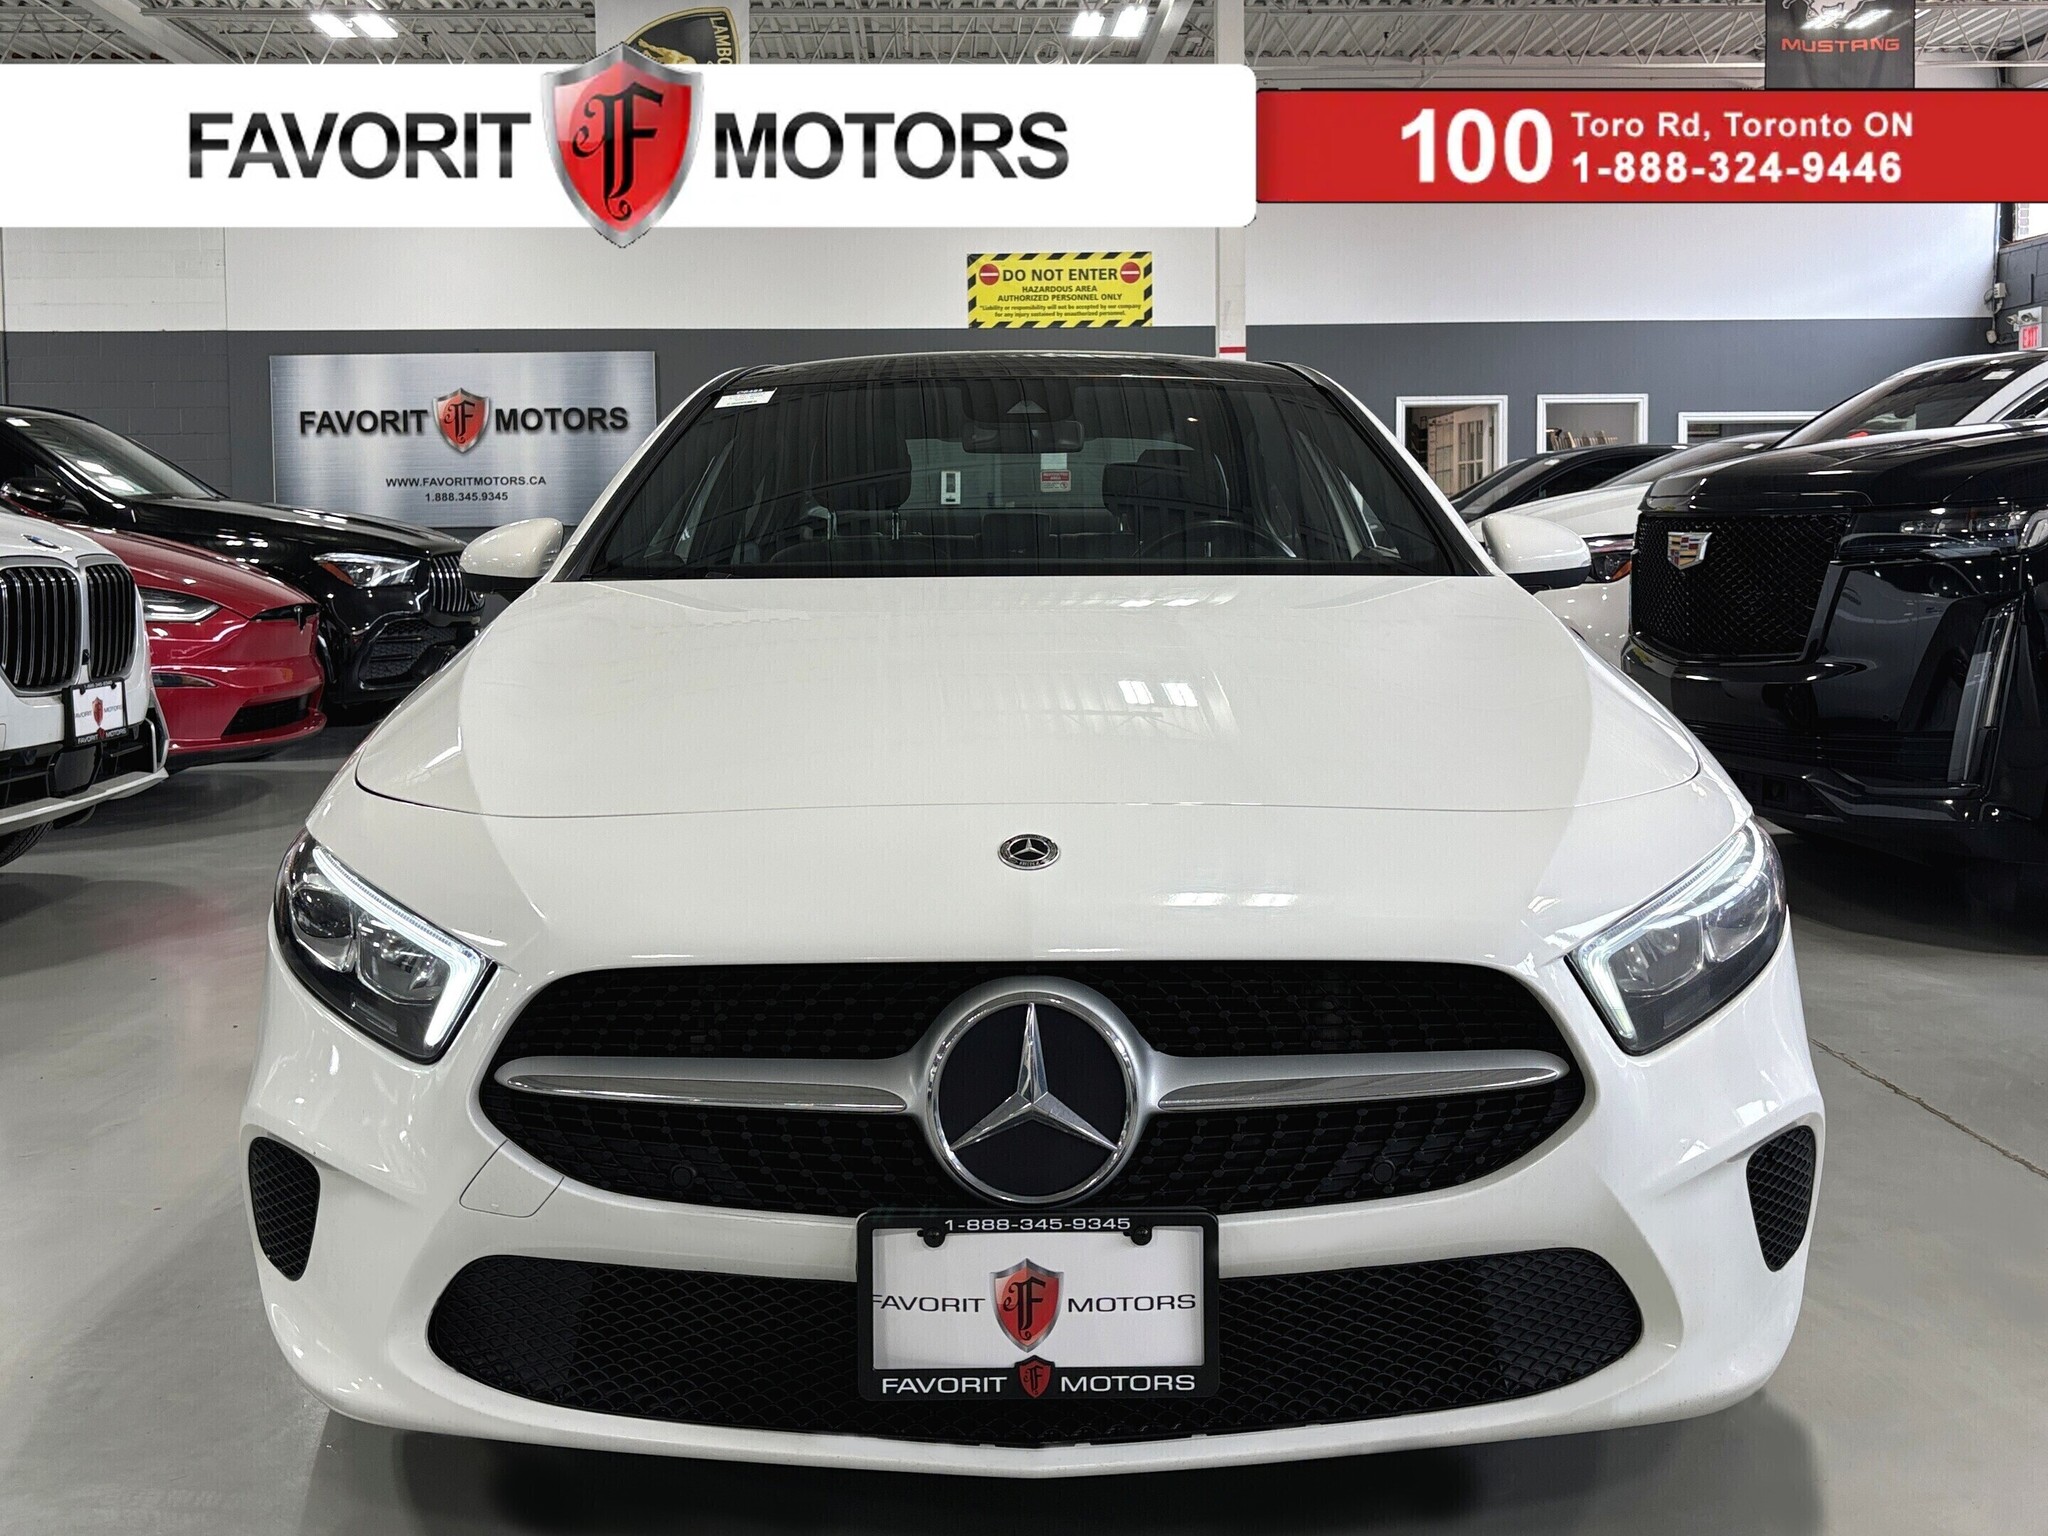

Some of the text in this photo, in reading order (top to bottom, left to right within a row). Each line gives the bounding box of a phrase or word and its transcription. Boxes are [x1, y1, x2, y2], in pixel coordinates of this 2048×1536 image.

[1781, 37, 1900, 53] MUSTANG
[1003, 268, 1118, 282] DO NOT ENTER
[1022, 285, 1073, 293] HAZARDOUS
[998, 294, 1049, 302] AUTHORIZED
[1101, 293, 1123, 301] ONLY
[299, 409, 428, 434] FAVORIT
[495, 407, 628, 432] MOTORS
[385, 476, 547, 488] WWW.FAVORITMOTORS.CA
[424, 492, 508, 503] 1.888.345.9345
[944, 1218, 1131, 1232] 1-888-345-9345
[1068, 1294, 1196, 1313] MOTORS
[882, 1376, 1008, 1394] FAVORIT
[1061, 1375, 1196, 1392] MOTORS
